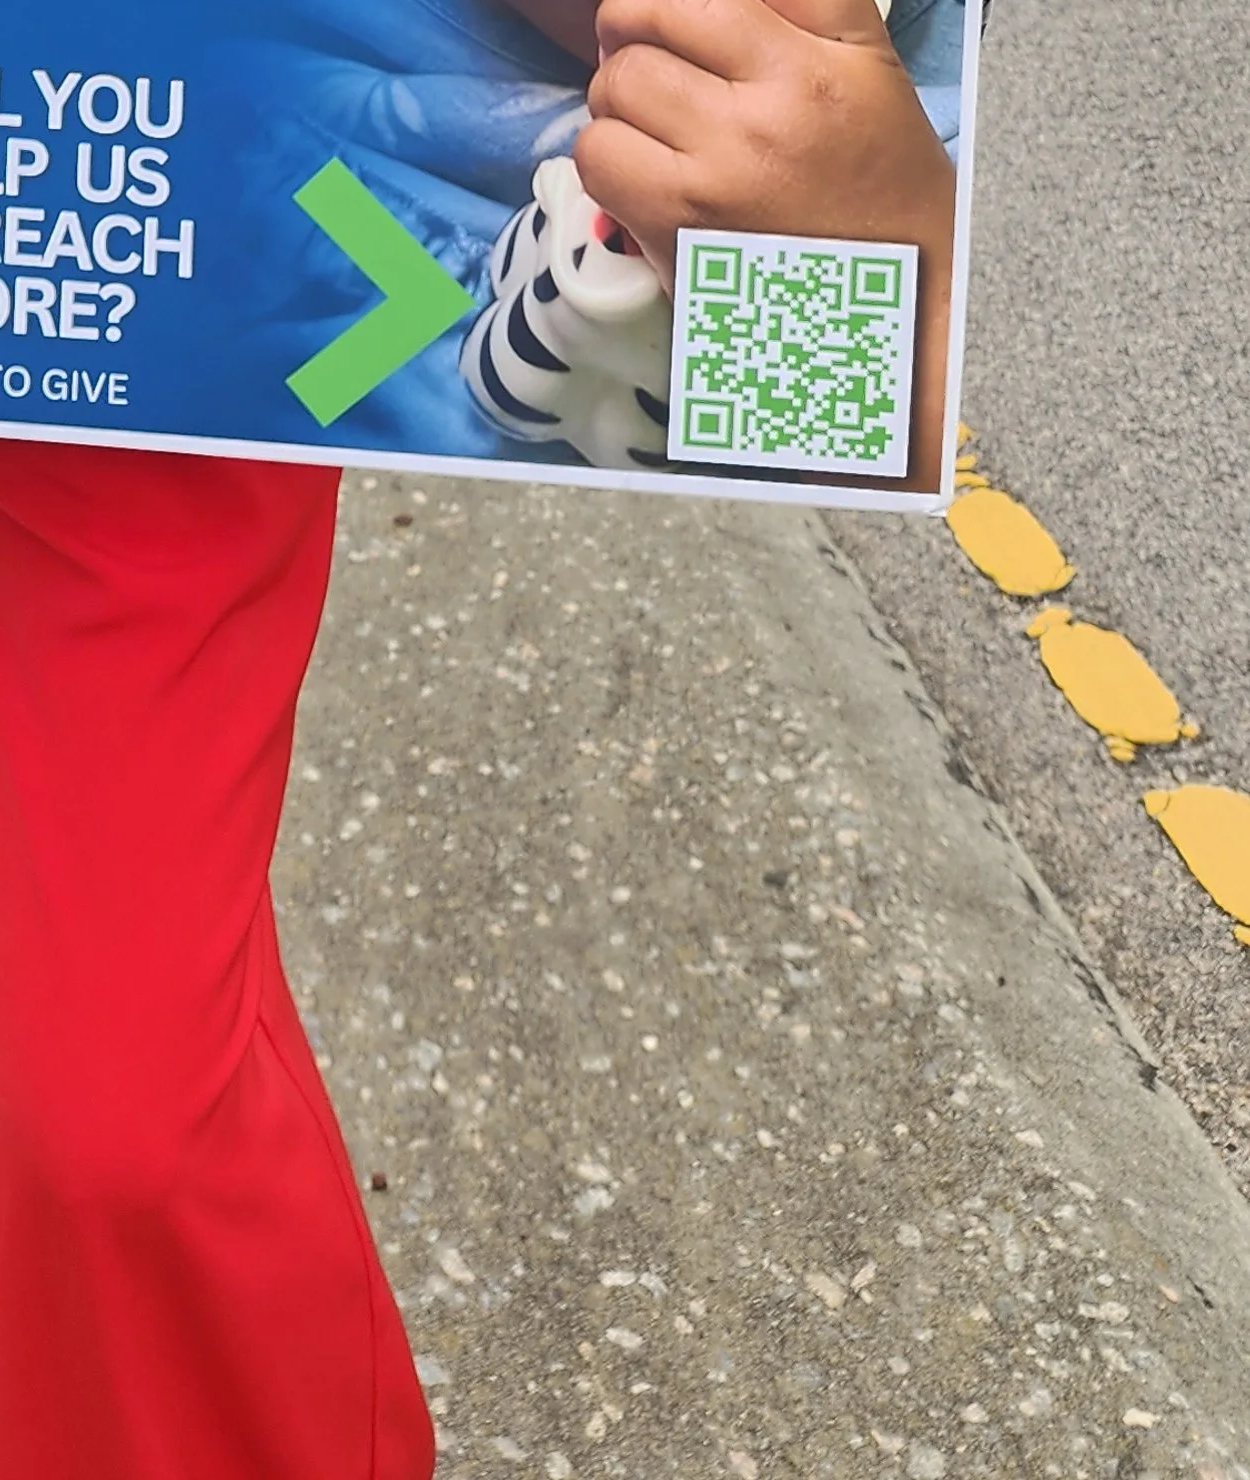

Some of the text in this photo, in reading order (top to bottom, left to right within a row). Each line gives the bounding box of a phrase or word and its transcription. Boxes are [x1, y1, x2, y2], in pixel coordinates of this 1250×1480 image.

[33, 68, 186, 139] YOU
[76, 142, 171, 208] US
[42, 369, 130, 407] GIVE
